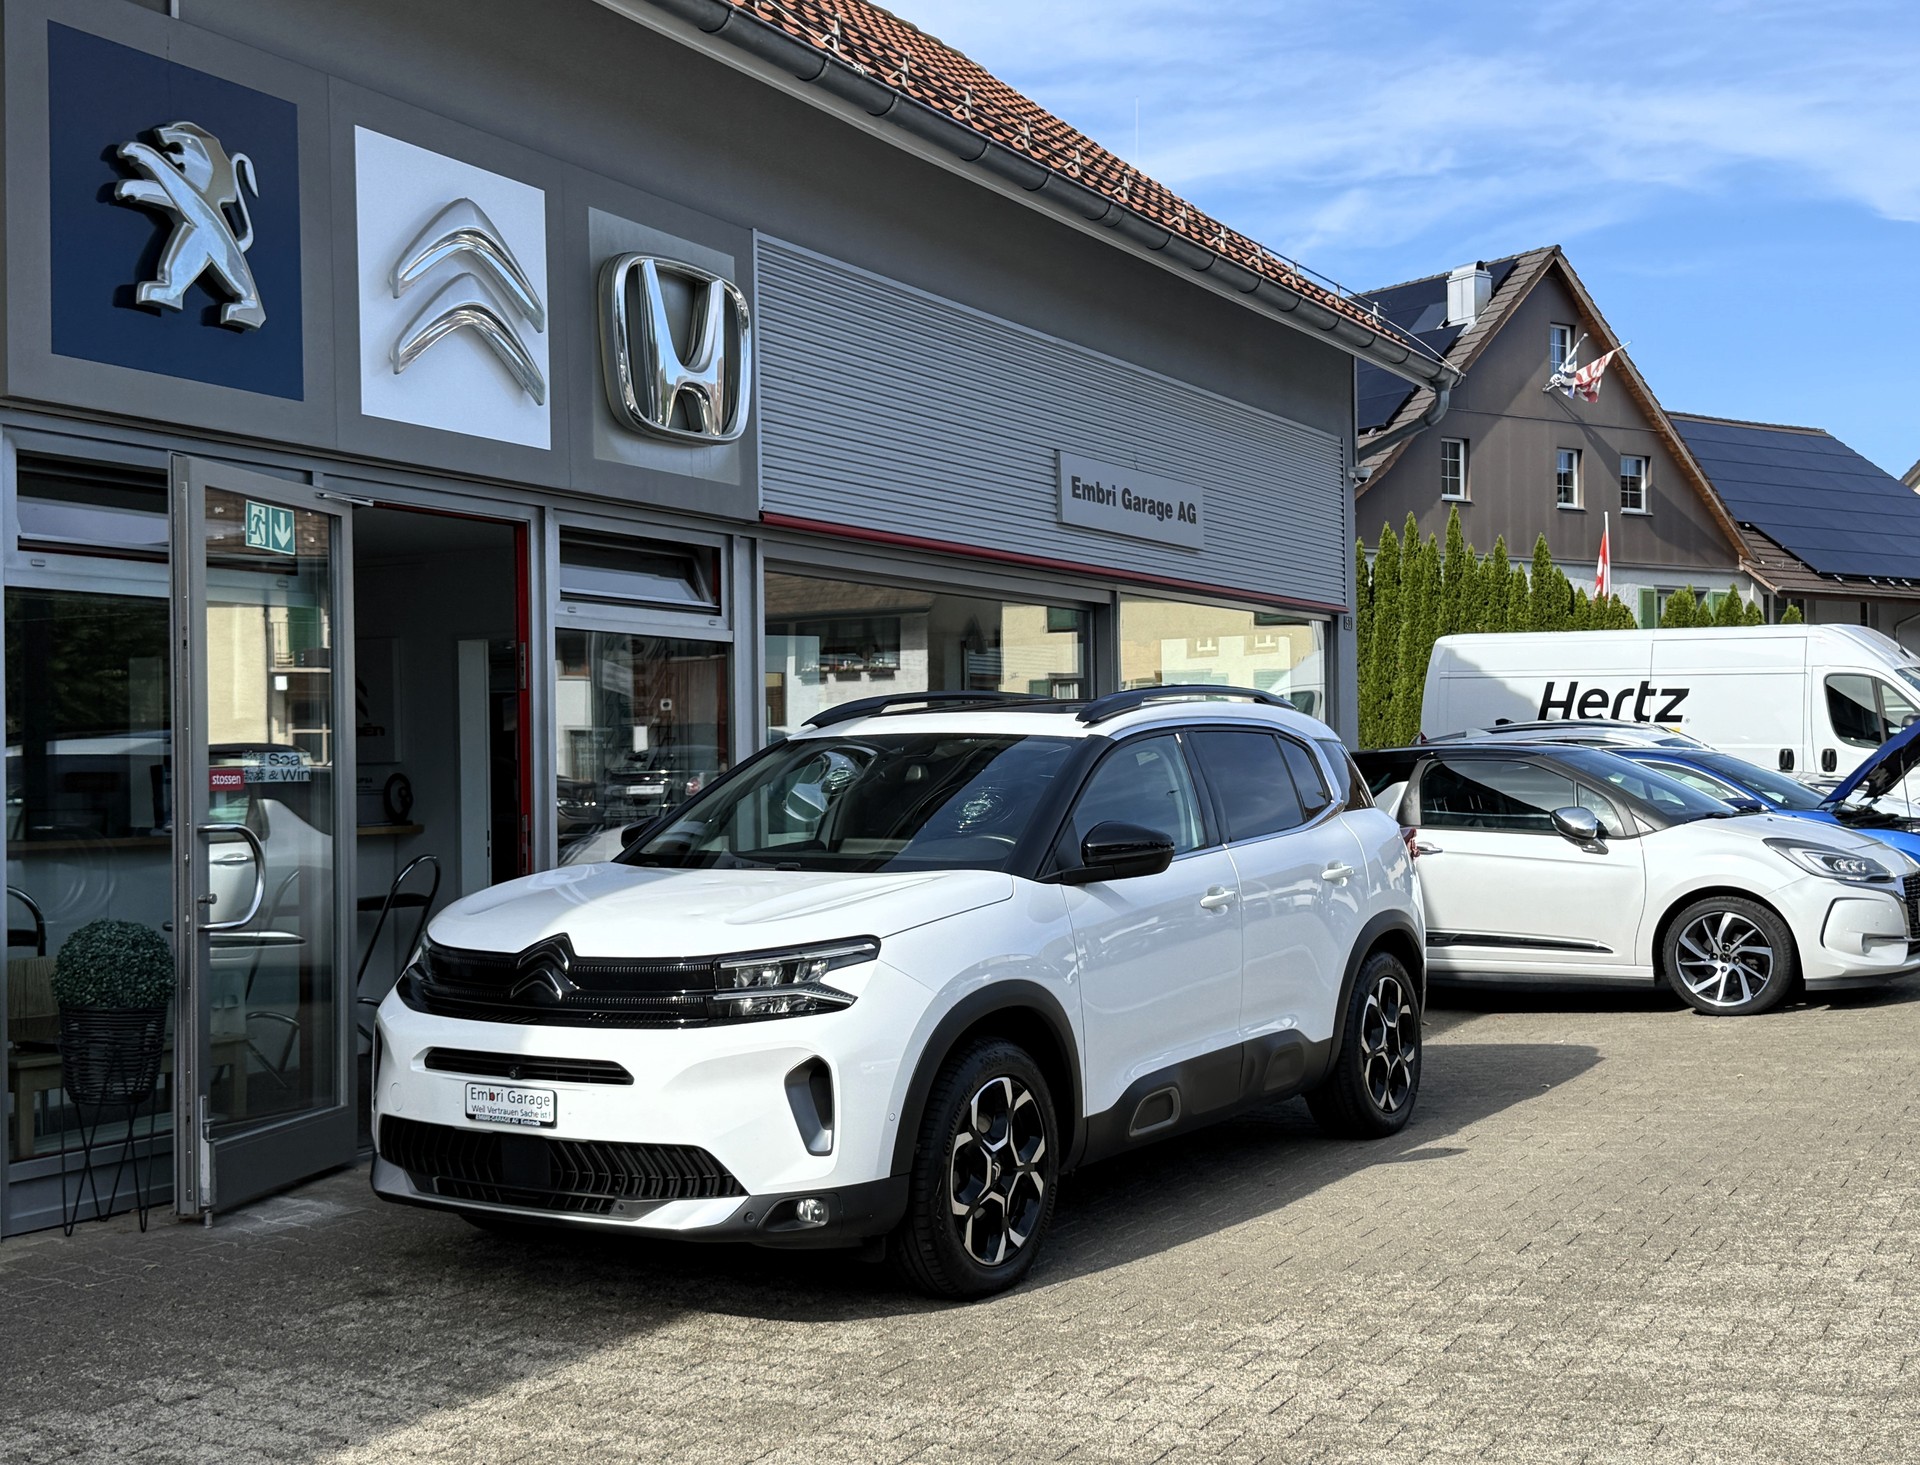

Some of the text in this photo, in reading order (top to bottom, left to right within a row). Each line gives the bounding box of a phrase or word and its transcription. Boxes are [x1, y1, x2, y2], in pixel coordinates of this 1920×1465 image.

[1071, 475, 1197, 525] Embri Garage AG
[1537, 680, 1690, 723] Hertz
[211, 774, 242, 785] stossen
[268, 766, 311, 780] & Win
[470, 1087, 550, 1110] Embri Garage
[471, 1104, 486, 1113] Weil
[487, 1106, 519, 1117] Vertrauen
[520, 1108, 539, 1119] Sache
